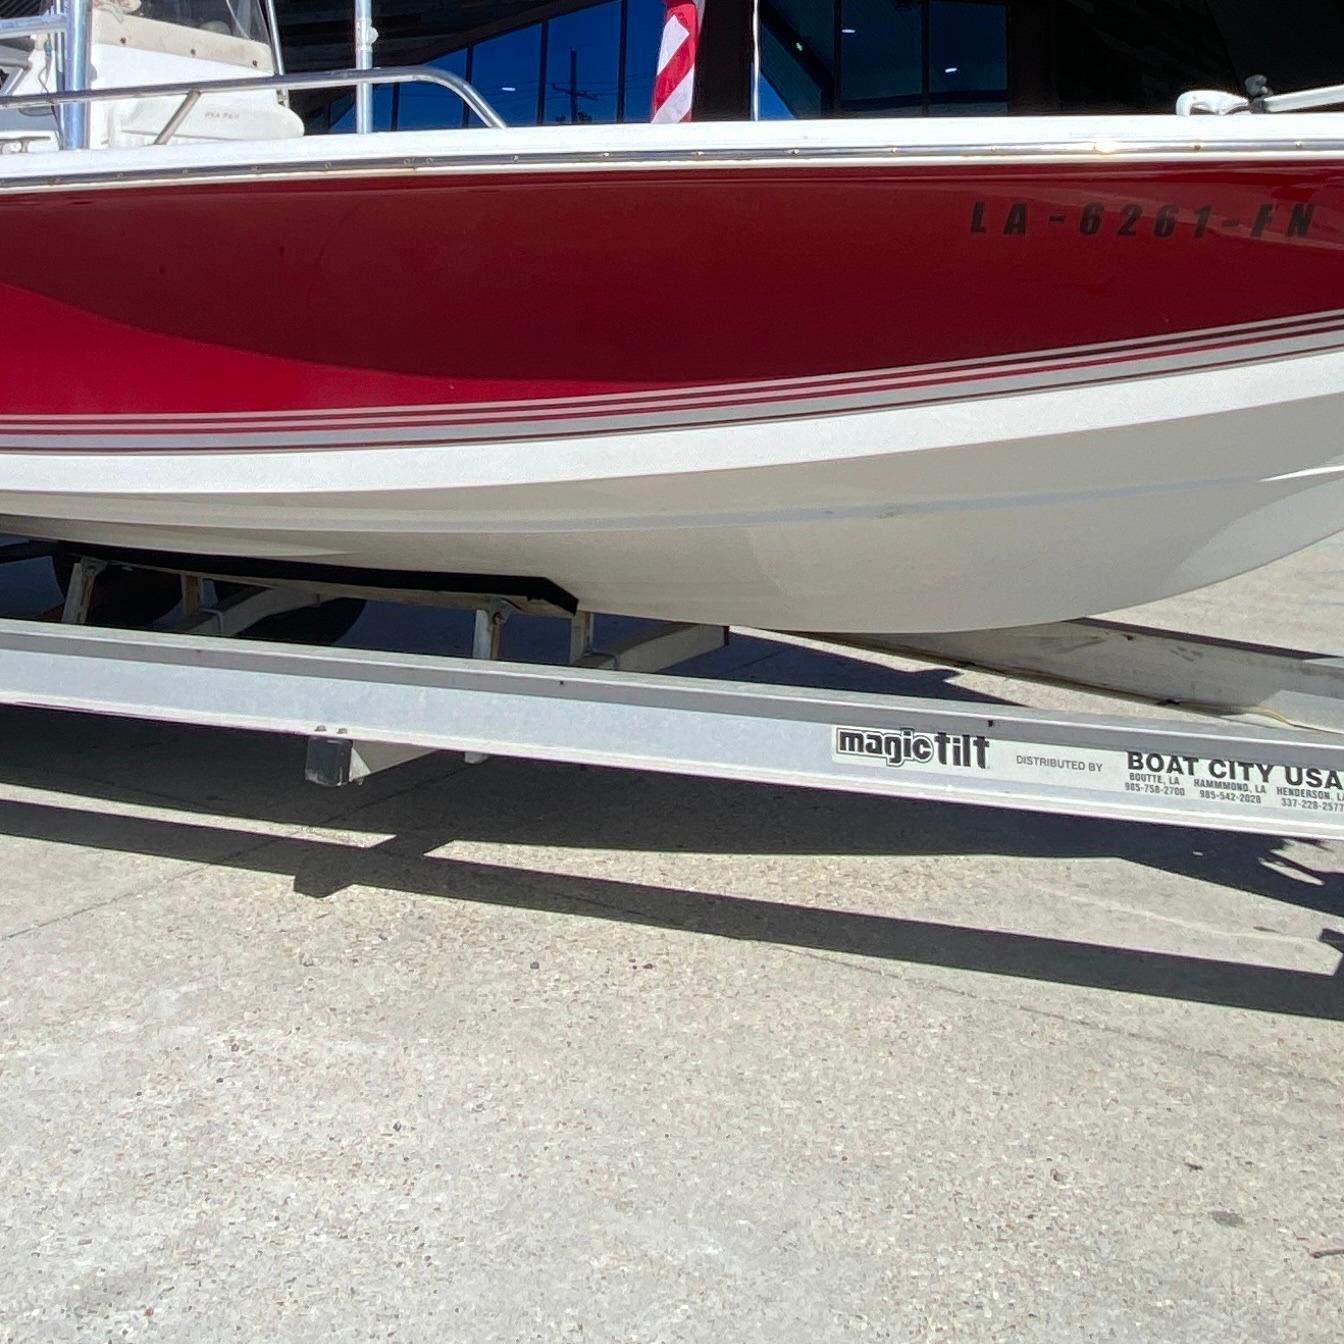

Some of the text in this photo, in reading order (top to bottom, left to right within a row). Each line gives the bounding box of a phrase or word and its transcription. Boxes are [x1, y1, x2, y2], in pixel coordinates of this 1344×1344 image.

[837, 728, 990, 769] magic tilt
[1016, 754, 1104, 773] DISTRIBUTED BY
[1127, 751, 1344, 790] BOAT CITY USA
[1169, 776, 1180, 785] LA
[1254, 784, 1267, 794] LA
